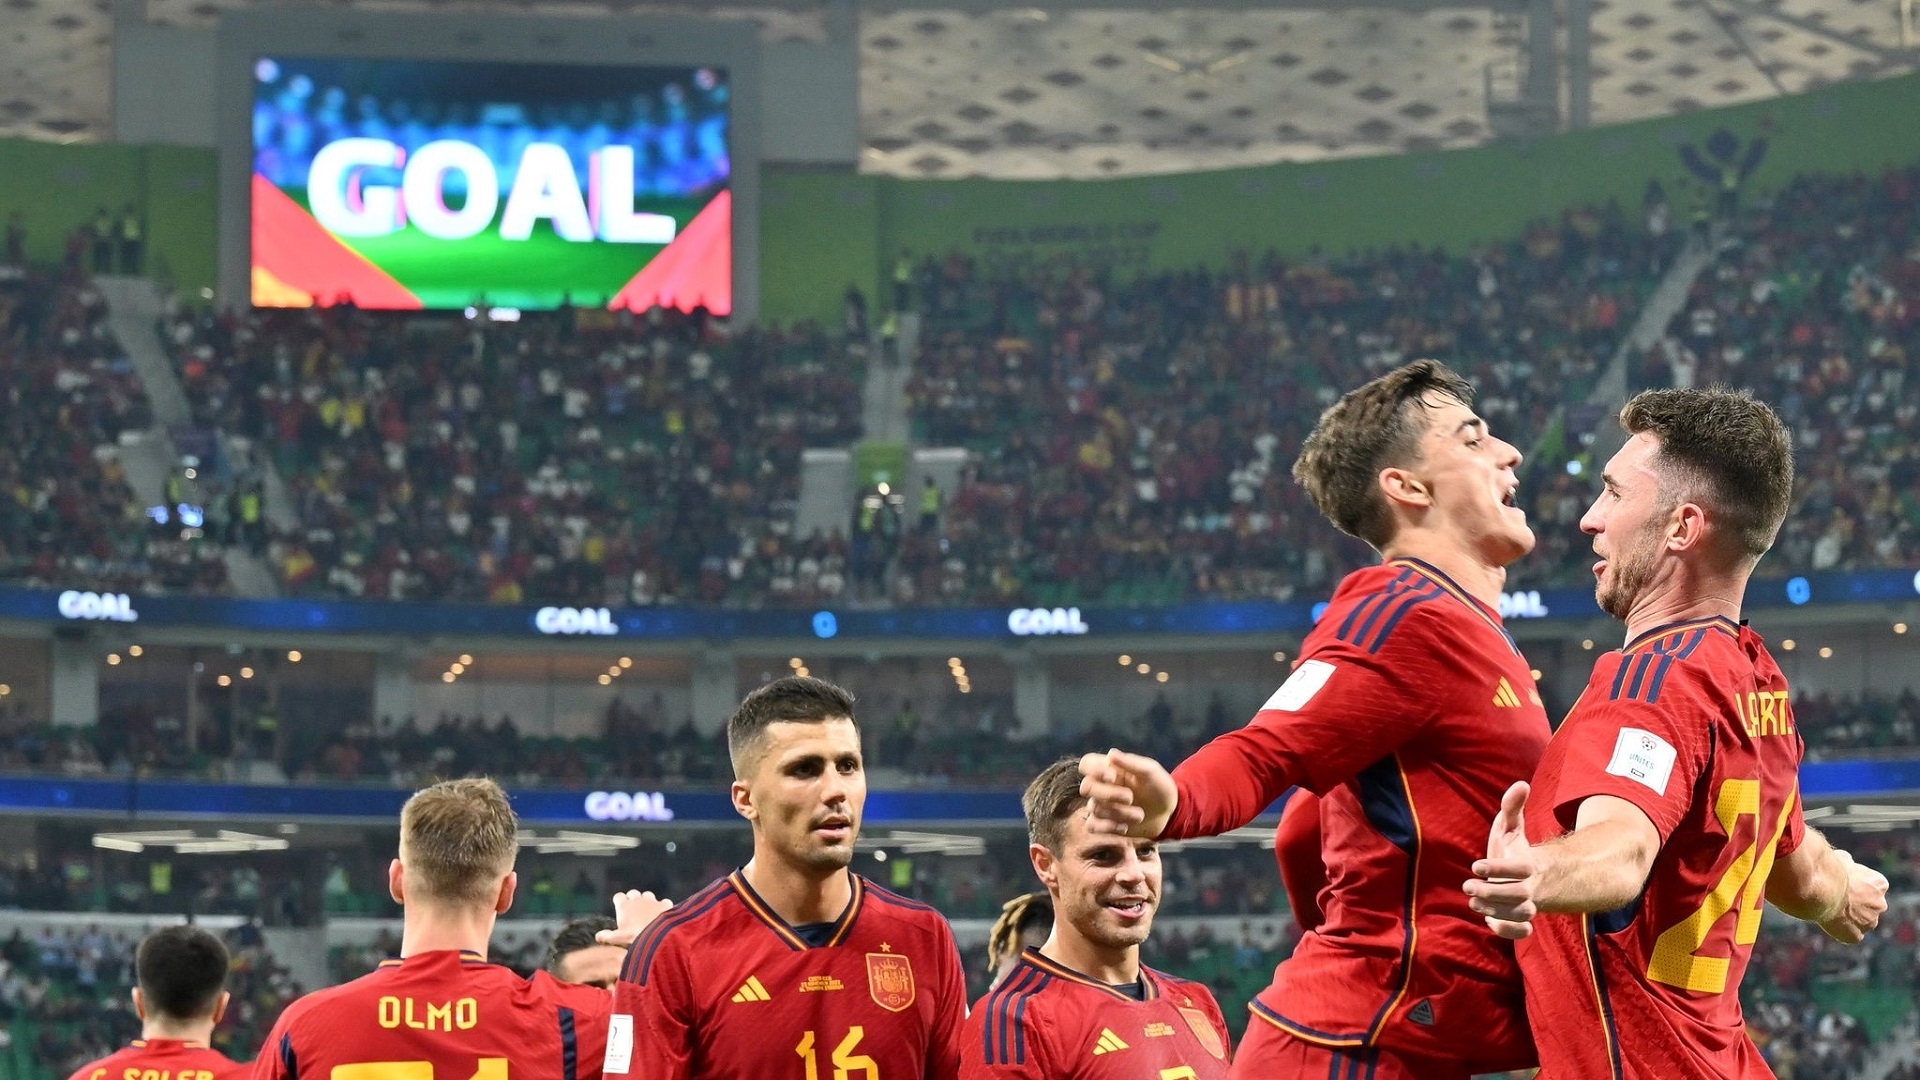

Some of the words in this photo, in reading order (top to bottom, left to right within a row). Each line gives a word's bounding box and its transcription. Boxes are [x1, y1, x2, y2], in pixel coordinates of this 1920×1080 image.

[307, 136, 677, 244] GOAL
[58, 590, 138, 622] GOAL
[1499, 591, 1549, 618] OAL
[535, 606, 619, 635] GOAL
[1008, 607, 1089, 635] GOAL
[584, 791, 674, 821] GOAL
[379, 995, 477, 1032] OLMO
[795, 1026, 879, 1080] 16
